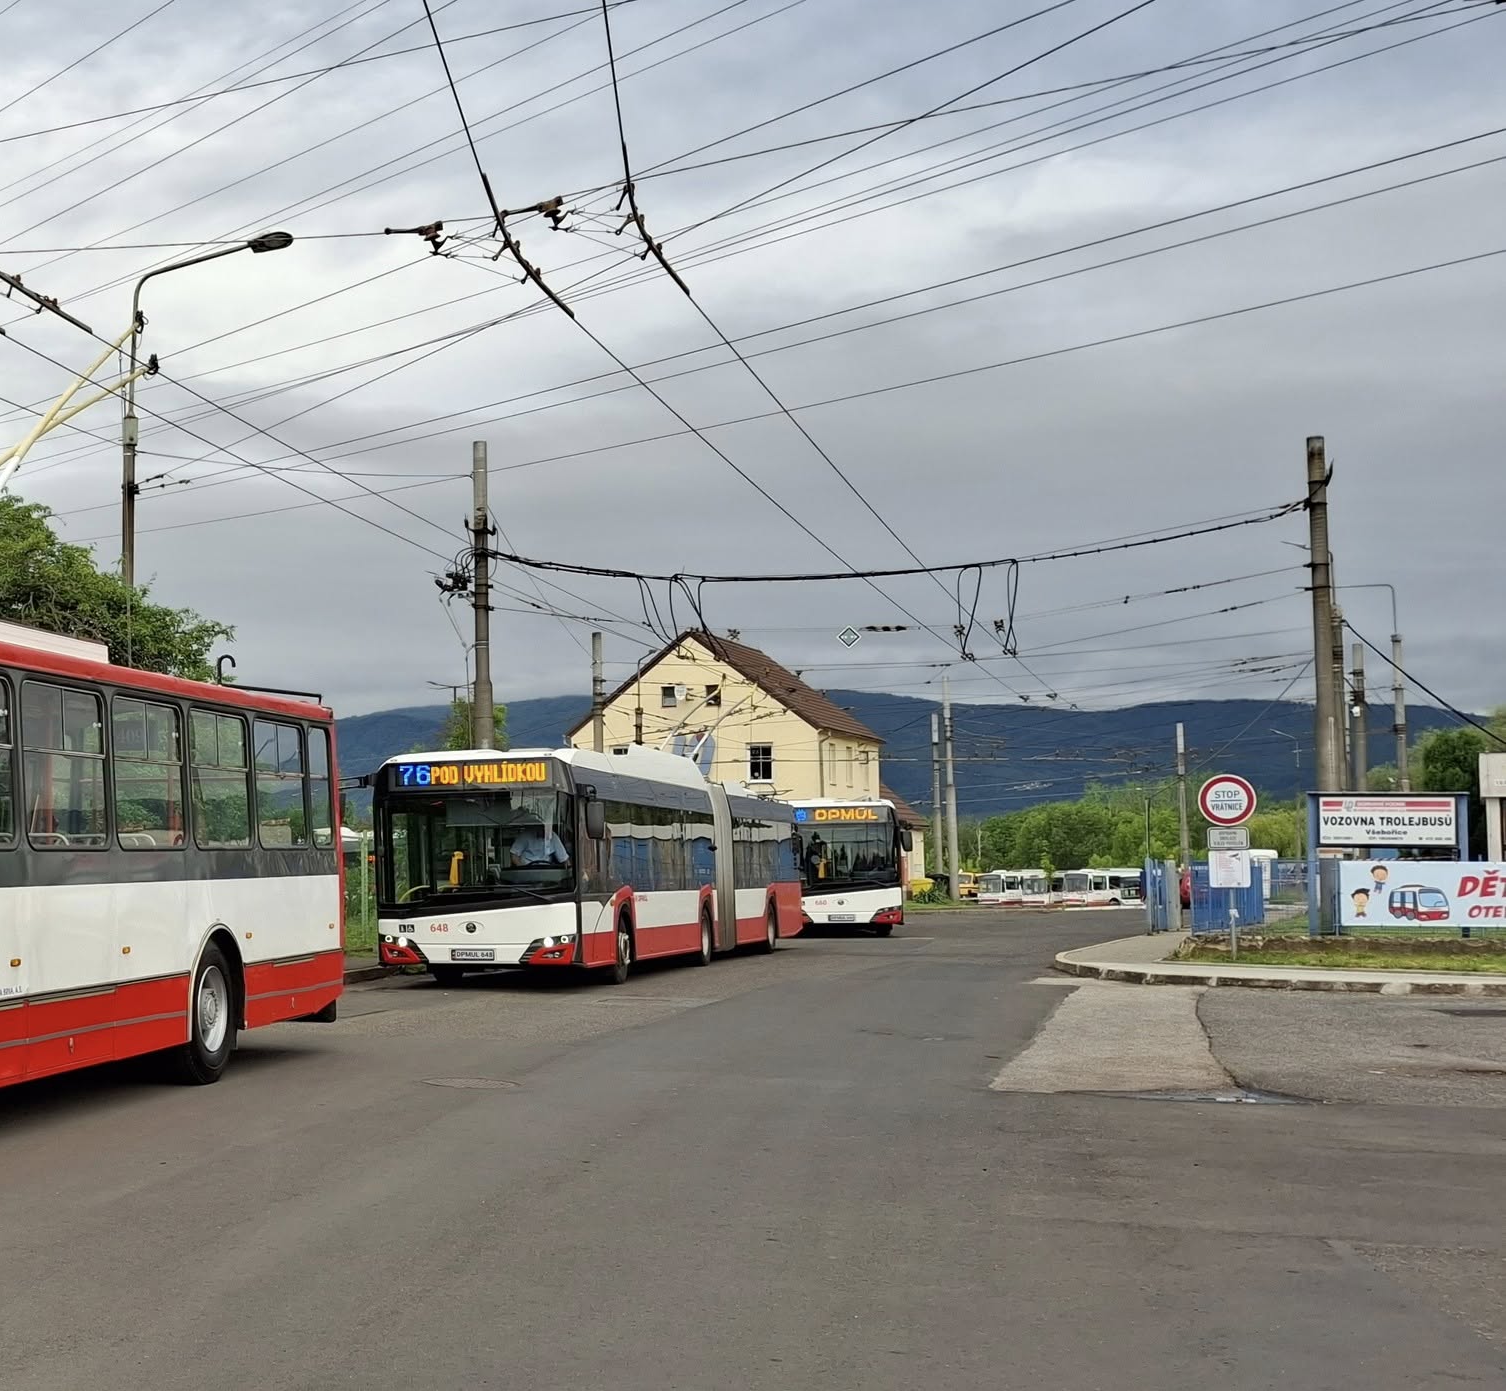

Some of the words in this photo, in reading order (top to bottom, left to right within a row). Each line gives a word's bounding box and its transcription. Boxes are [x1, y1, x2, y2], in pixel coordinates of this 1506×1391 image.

[399, 765, 431, 786] 76
[431, 766, 459, 785] POD
[464, 761, 546, 784] VYHLÍDKOU
[1214, 790, 1240, 799] STOP
[1211, 802, 1243, 811] VRÁTNICE
[1323, 816, 1376, 827] VOZOVNA
[1379, 814, 1453, 827] TROLEJBUSŮ
[1468, 905, 1506, 918] OTE
[429, 923, 449, 933] 648
